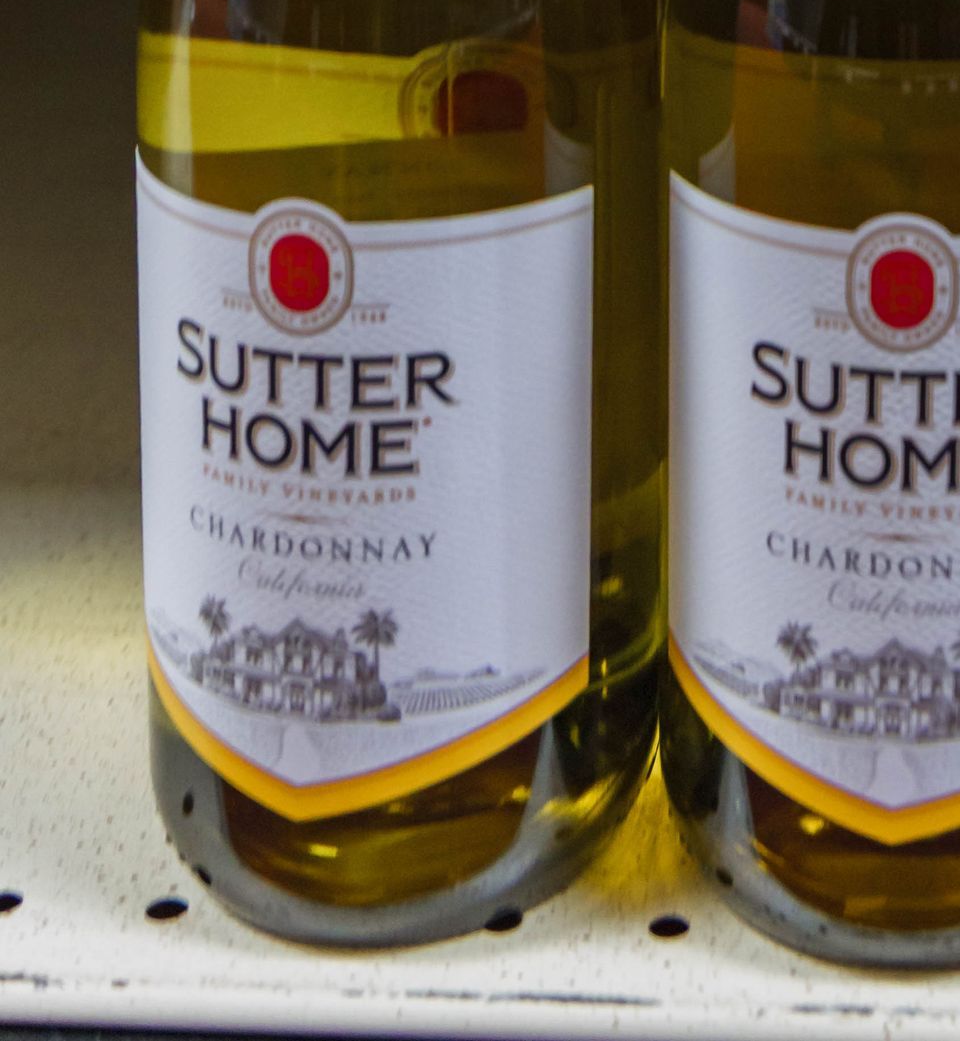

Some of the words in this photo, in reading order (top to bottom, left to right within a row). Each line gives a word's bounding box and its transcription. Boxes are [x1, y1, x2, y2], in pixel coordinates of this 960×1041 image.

[177, 318, 457, 410] SUTTER
[202, 397, 420, 478] HOME
[203, 464, 269, 496] FAMILY
[282, 482, 416, 505] VINEYARDS
[785, 486, 865, 517] FAMILY
[190, 504, 437, 562] CHARDONNAY
[238, 556, 367, 600] California
